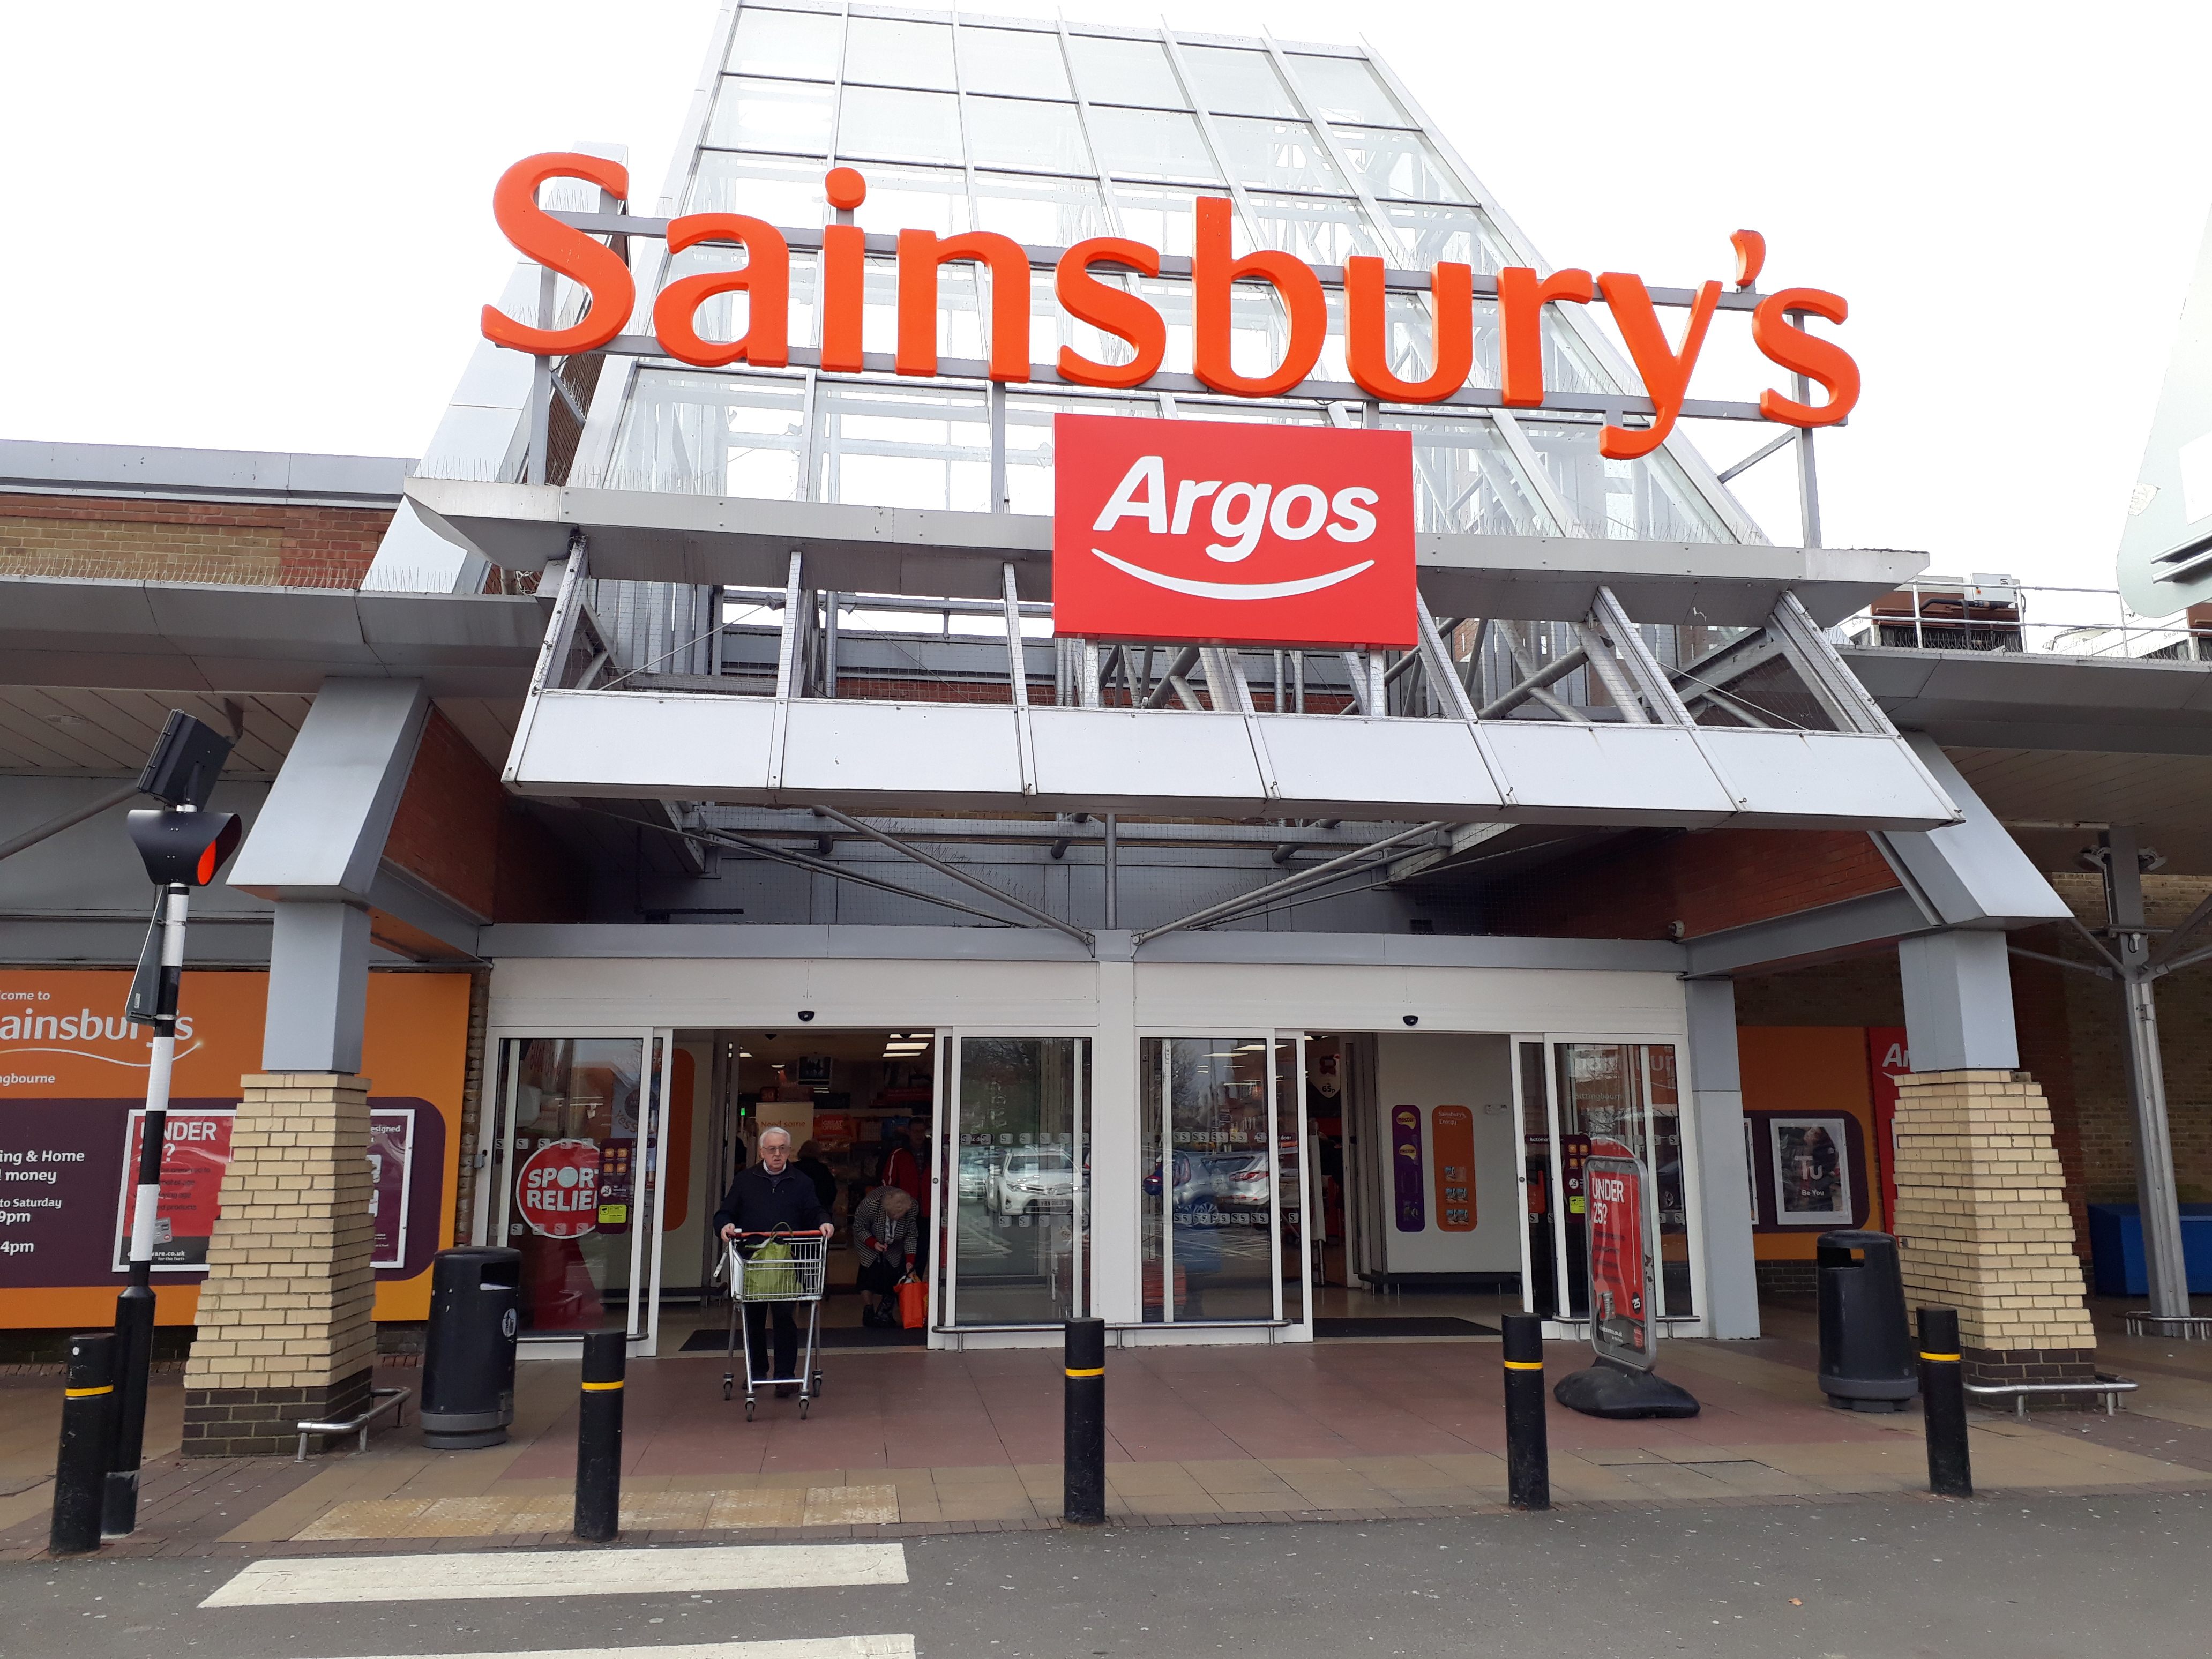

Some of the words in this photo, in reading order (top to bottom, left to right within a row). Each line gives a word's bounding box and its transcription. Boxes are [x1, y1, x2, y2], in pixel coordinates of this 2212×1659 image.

[481, 153, 1860, 460] Sainsbury's
[1092, 455, 1379, 564] Argos
[0, 990, 34, 1000] come
[38, 991, 50, 1000] to
[370, 1125, 401, 1134] esigned
[26, 1150, 38, 1162] &
[42, 1150, 85, 1162] Home
[1795, 1156, 1822, 1179] Tu
[5, 1171, 57, 1184] money
[527, 1166, 599, 1188] SPOR
[1591, 1178, 1625, 1203] UNDER
[0, 1199, 11, 1207] to
[13, 1198, 62, 1209] Saturday
[1593, 1202, 1608, 1225] 25?
[1, 1241, 34, 1256] 4pm
